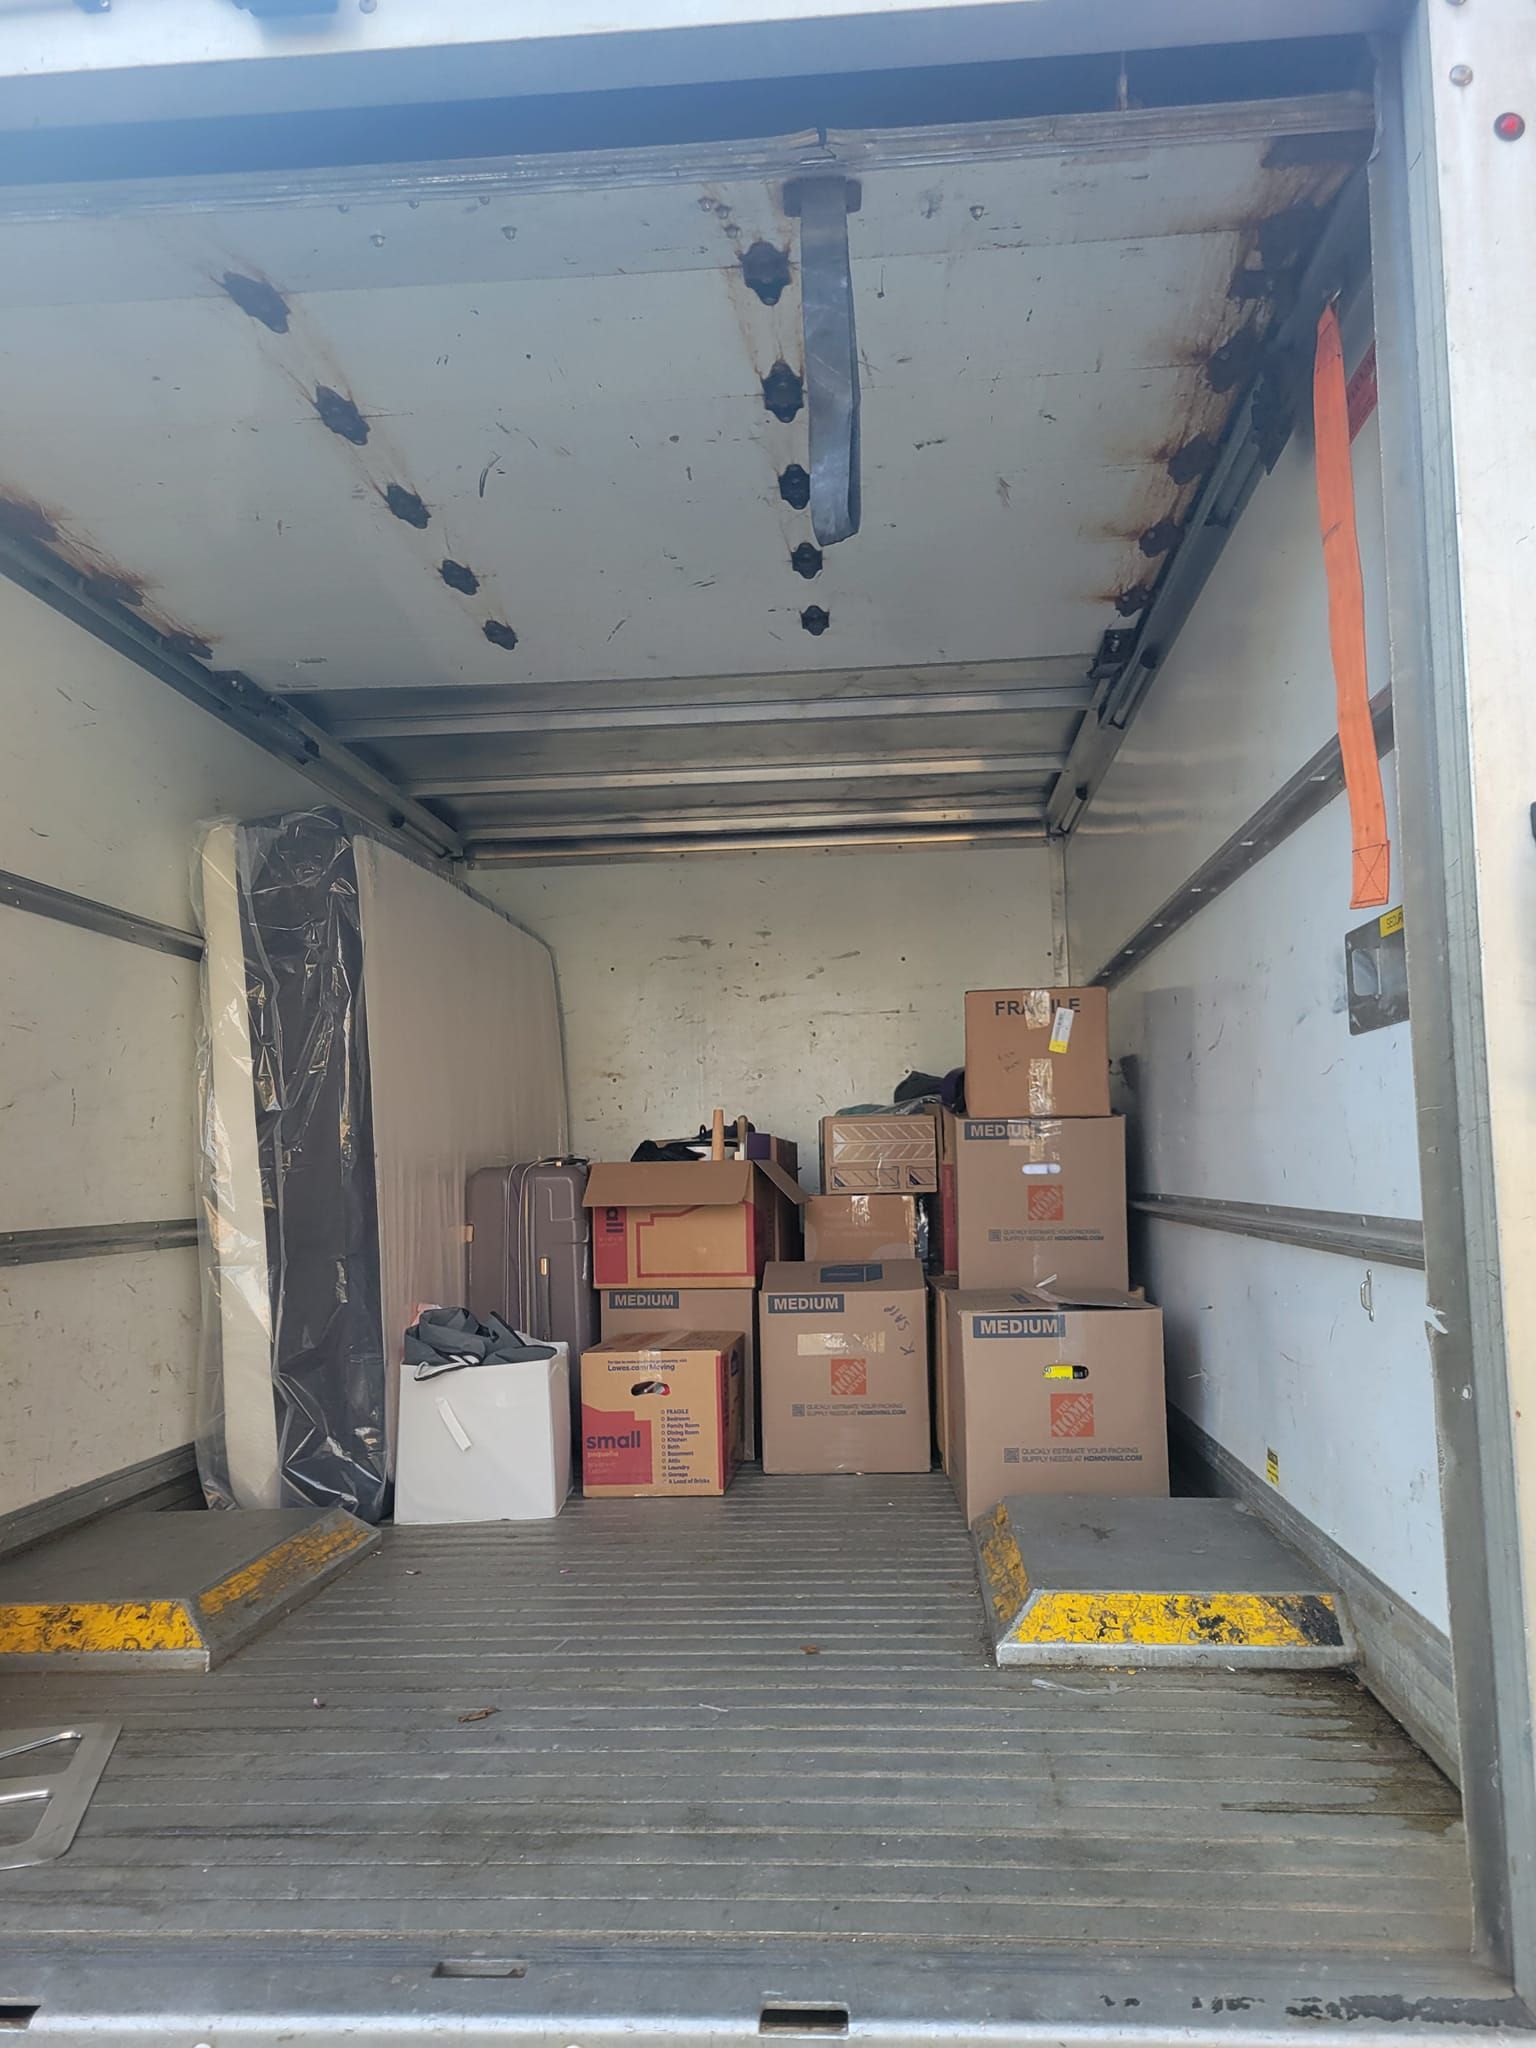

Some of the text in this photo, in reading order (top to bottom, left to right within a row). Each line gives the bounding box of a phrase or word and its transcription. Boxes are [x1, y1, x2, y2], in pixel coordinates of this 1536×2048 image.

[615, 1294, 674, 1306] MEDIUM
[774, 1297, 839, 1311] MEDIUM
[980, 1319, 1058, 1335] MEDIUM
[586, 1430, 641, 1449] small
